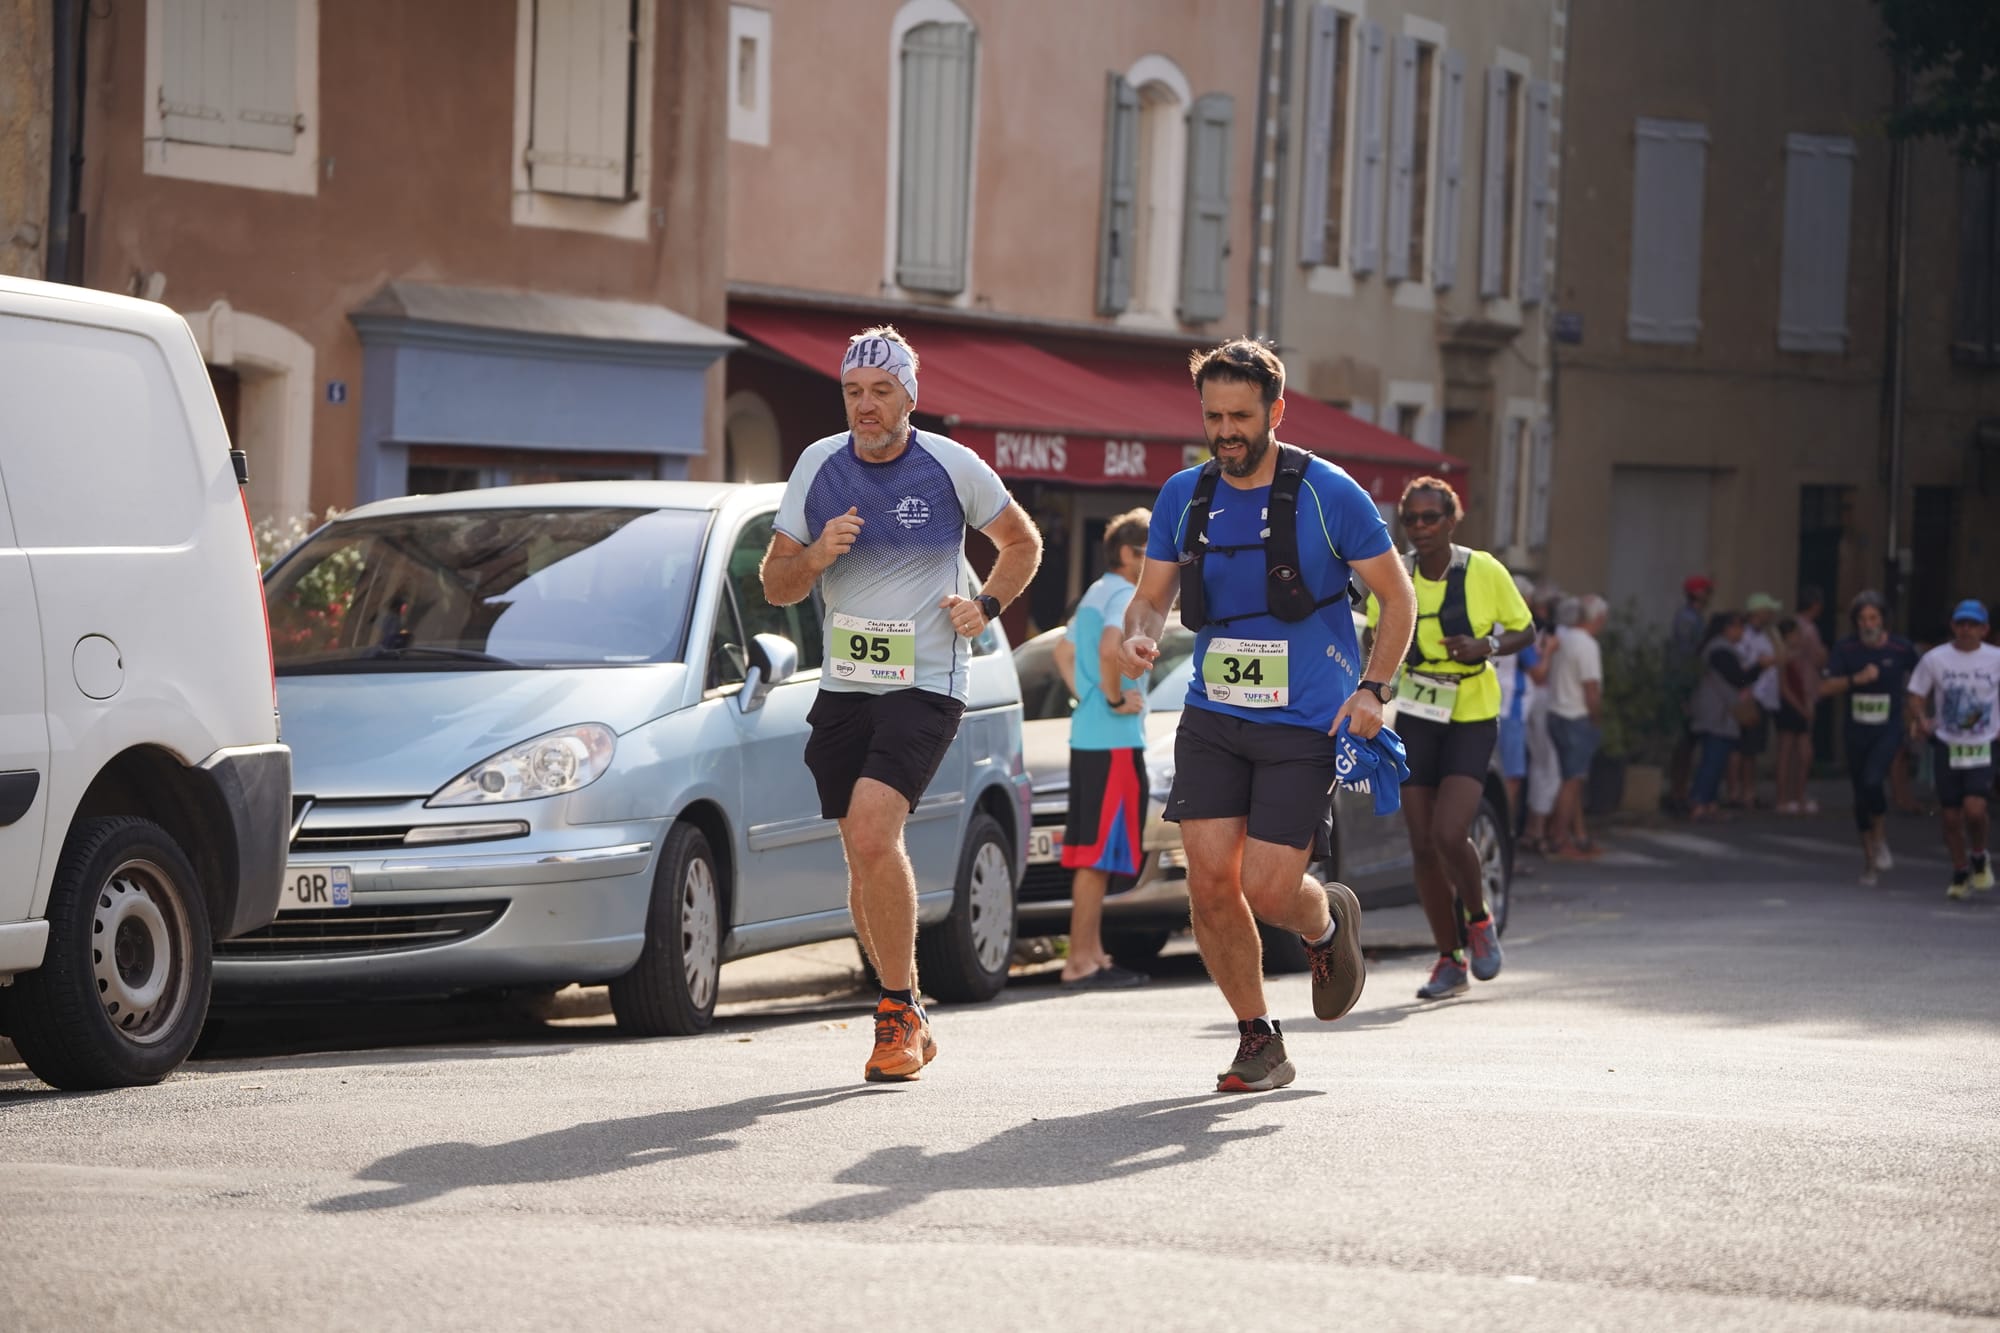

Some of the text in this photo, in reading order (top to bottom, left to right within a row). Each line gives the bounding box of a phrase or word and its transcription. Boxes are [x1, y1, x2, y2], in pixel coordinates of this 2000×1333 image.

[995, 433, 1147, 476] RYAN'S BAR
[850, 635, 890, 662] 95
[1223, 657, 1264, 685] 34
[1414, 682, 1437, 704] 71
[334, 887, 348, 900] 59
